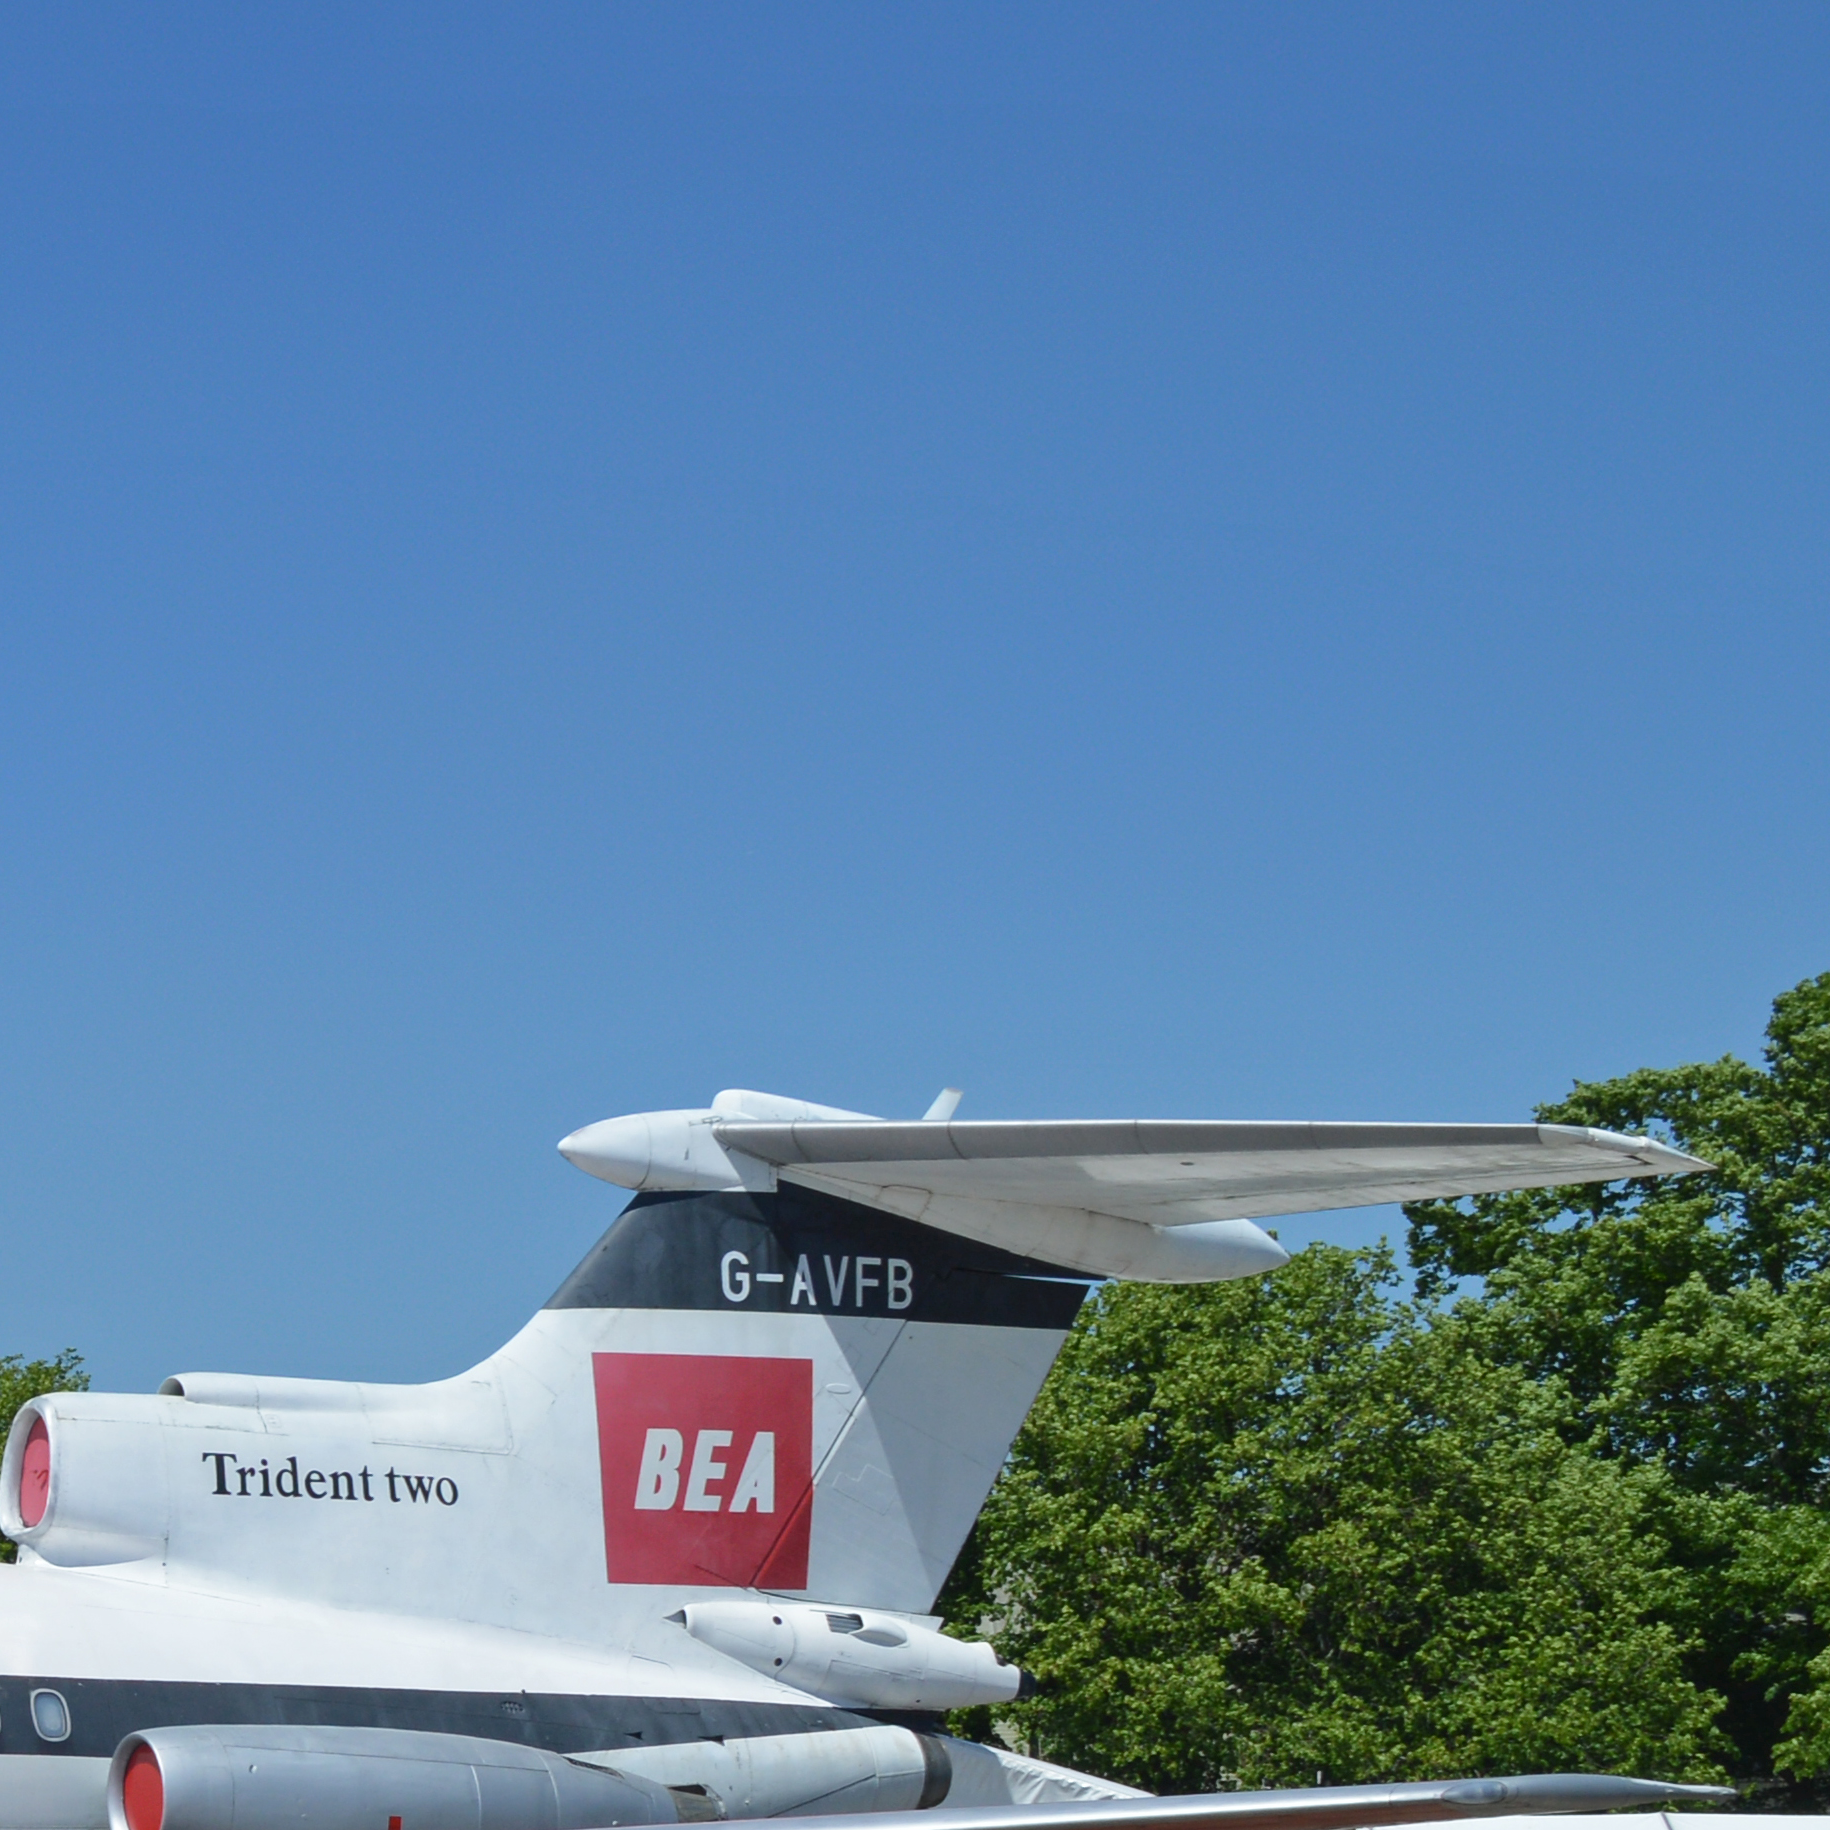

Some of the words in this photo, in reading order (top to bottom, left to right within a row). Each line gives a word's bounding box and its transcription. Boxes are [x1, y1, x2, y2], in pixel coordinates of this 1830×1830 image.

[720, 1250, 914, 1310] G-AVFB
[202, 1452, 374, 1502] Trident
[384, 1466, 459, 1506] two
[634, 1428, 775, 1513] BEA
